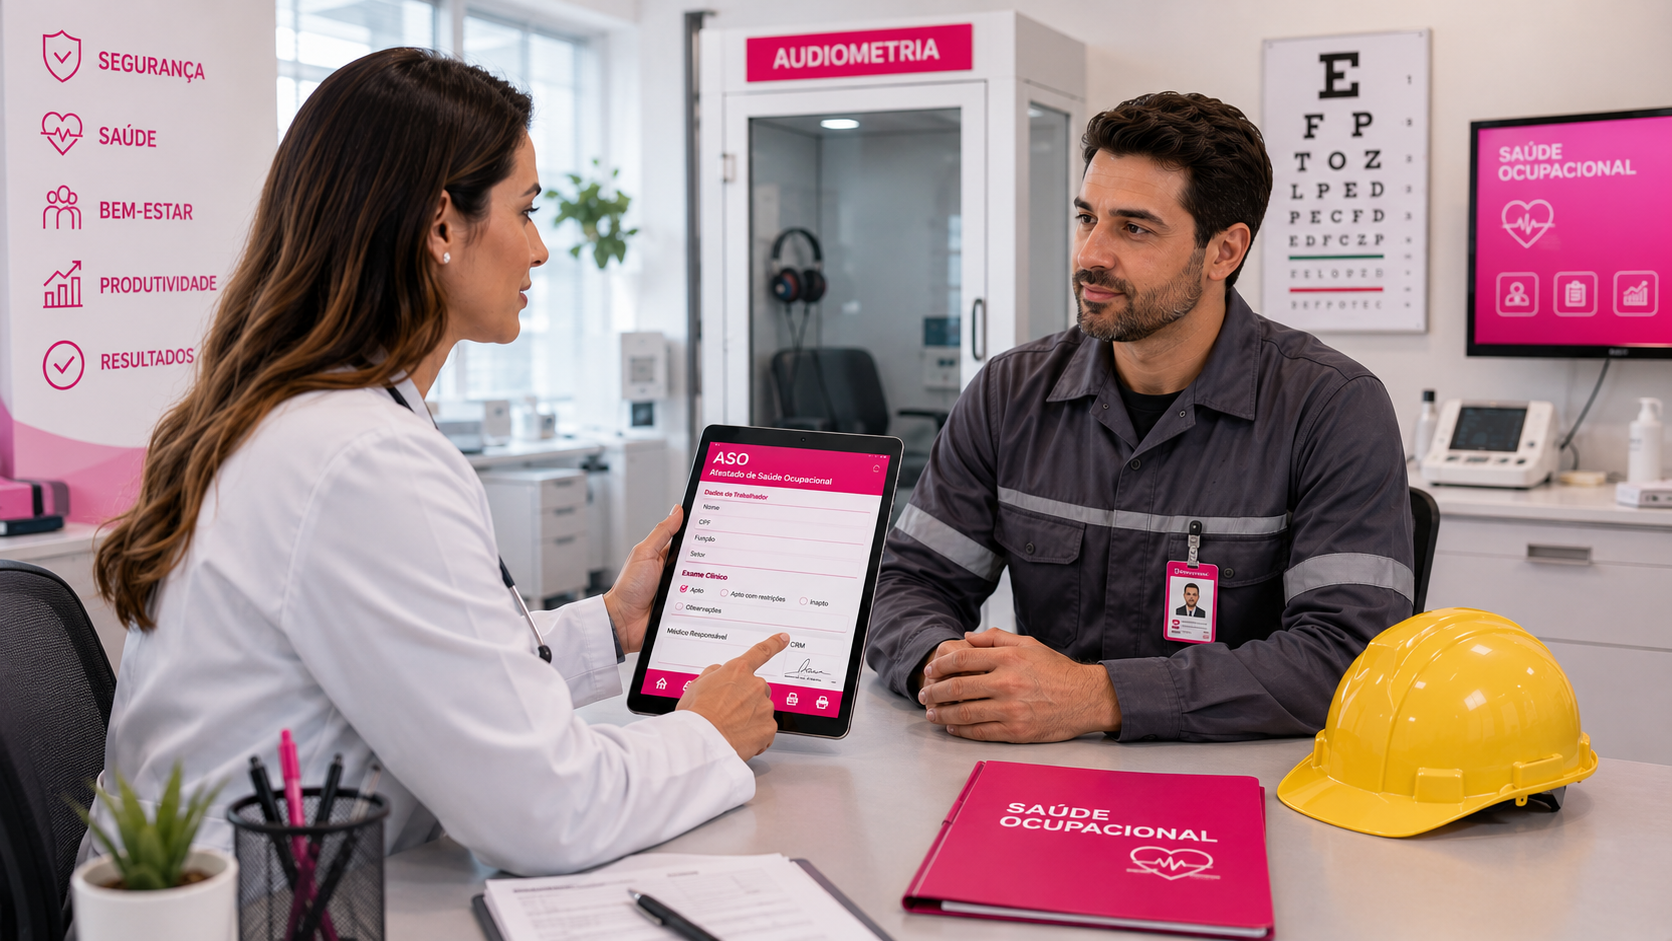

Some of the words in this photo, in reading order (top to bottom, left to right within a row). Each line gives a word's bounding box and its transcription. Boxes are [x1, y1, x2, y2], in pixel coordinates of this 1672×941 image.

[772, 38, 941, 70] AUDIOMETRIA
[98, 51, 205, 83] SEGURANÇA
[1318, 51, 1360, 100] E
[1303, 113, 1324, 140] F
[1351, 111, 1373, 138] P
[98, 123, 157, 148] SAÚDE
[1499, 141, 1563, 163] SAÚDE
[1498, 159, 1637, 181] OCUPACIONAL
[99, 200, 193, 221] BEM-ESTAR
[100, 275, 217, 294] PRODUTIVIDADE
[100, 347, 195, 371] RESULTADOS
[713, 451, 750, 466] ASO
[746, 471, 757, 480] de
[757, 472, 782, 481] Saúde
[783, 474, 833, 485] Ocupacional
[703, 503, 720, 511] Nome
[694, 533, 716, 543] Função
[690, 549, 706, 558] Setor
[682, 569, 705, 579] Exame
[690, 586, 705, 595] Apto
[730, 590, 745, 599] Apto
[790, 641, 806, 649] CRM
[1006, 802, 1111, 821] SAÚDE
[999, 815, 1218, 843] OCUPACIONAL
